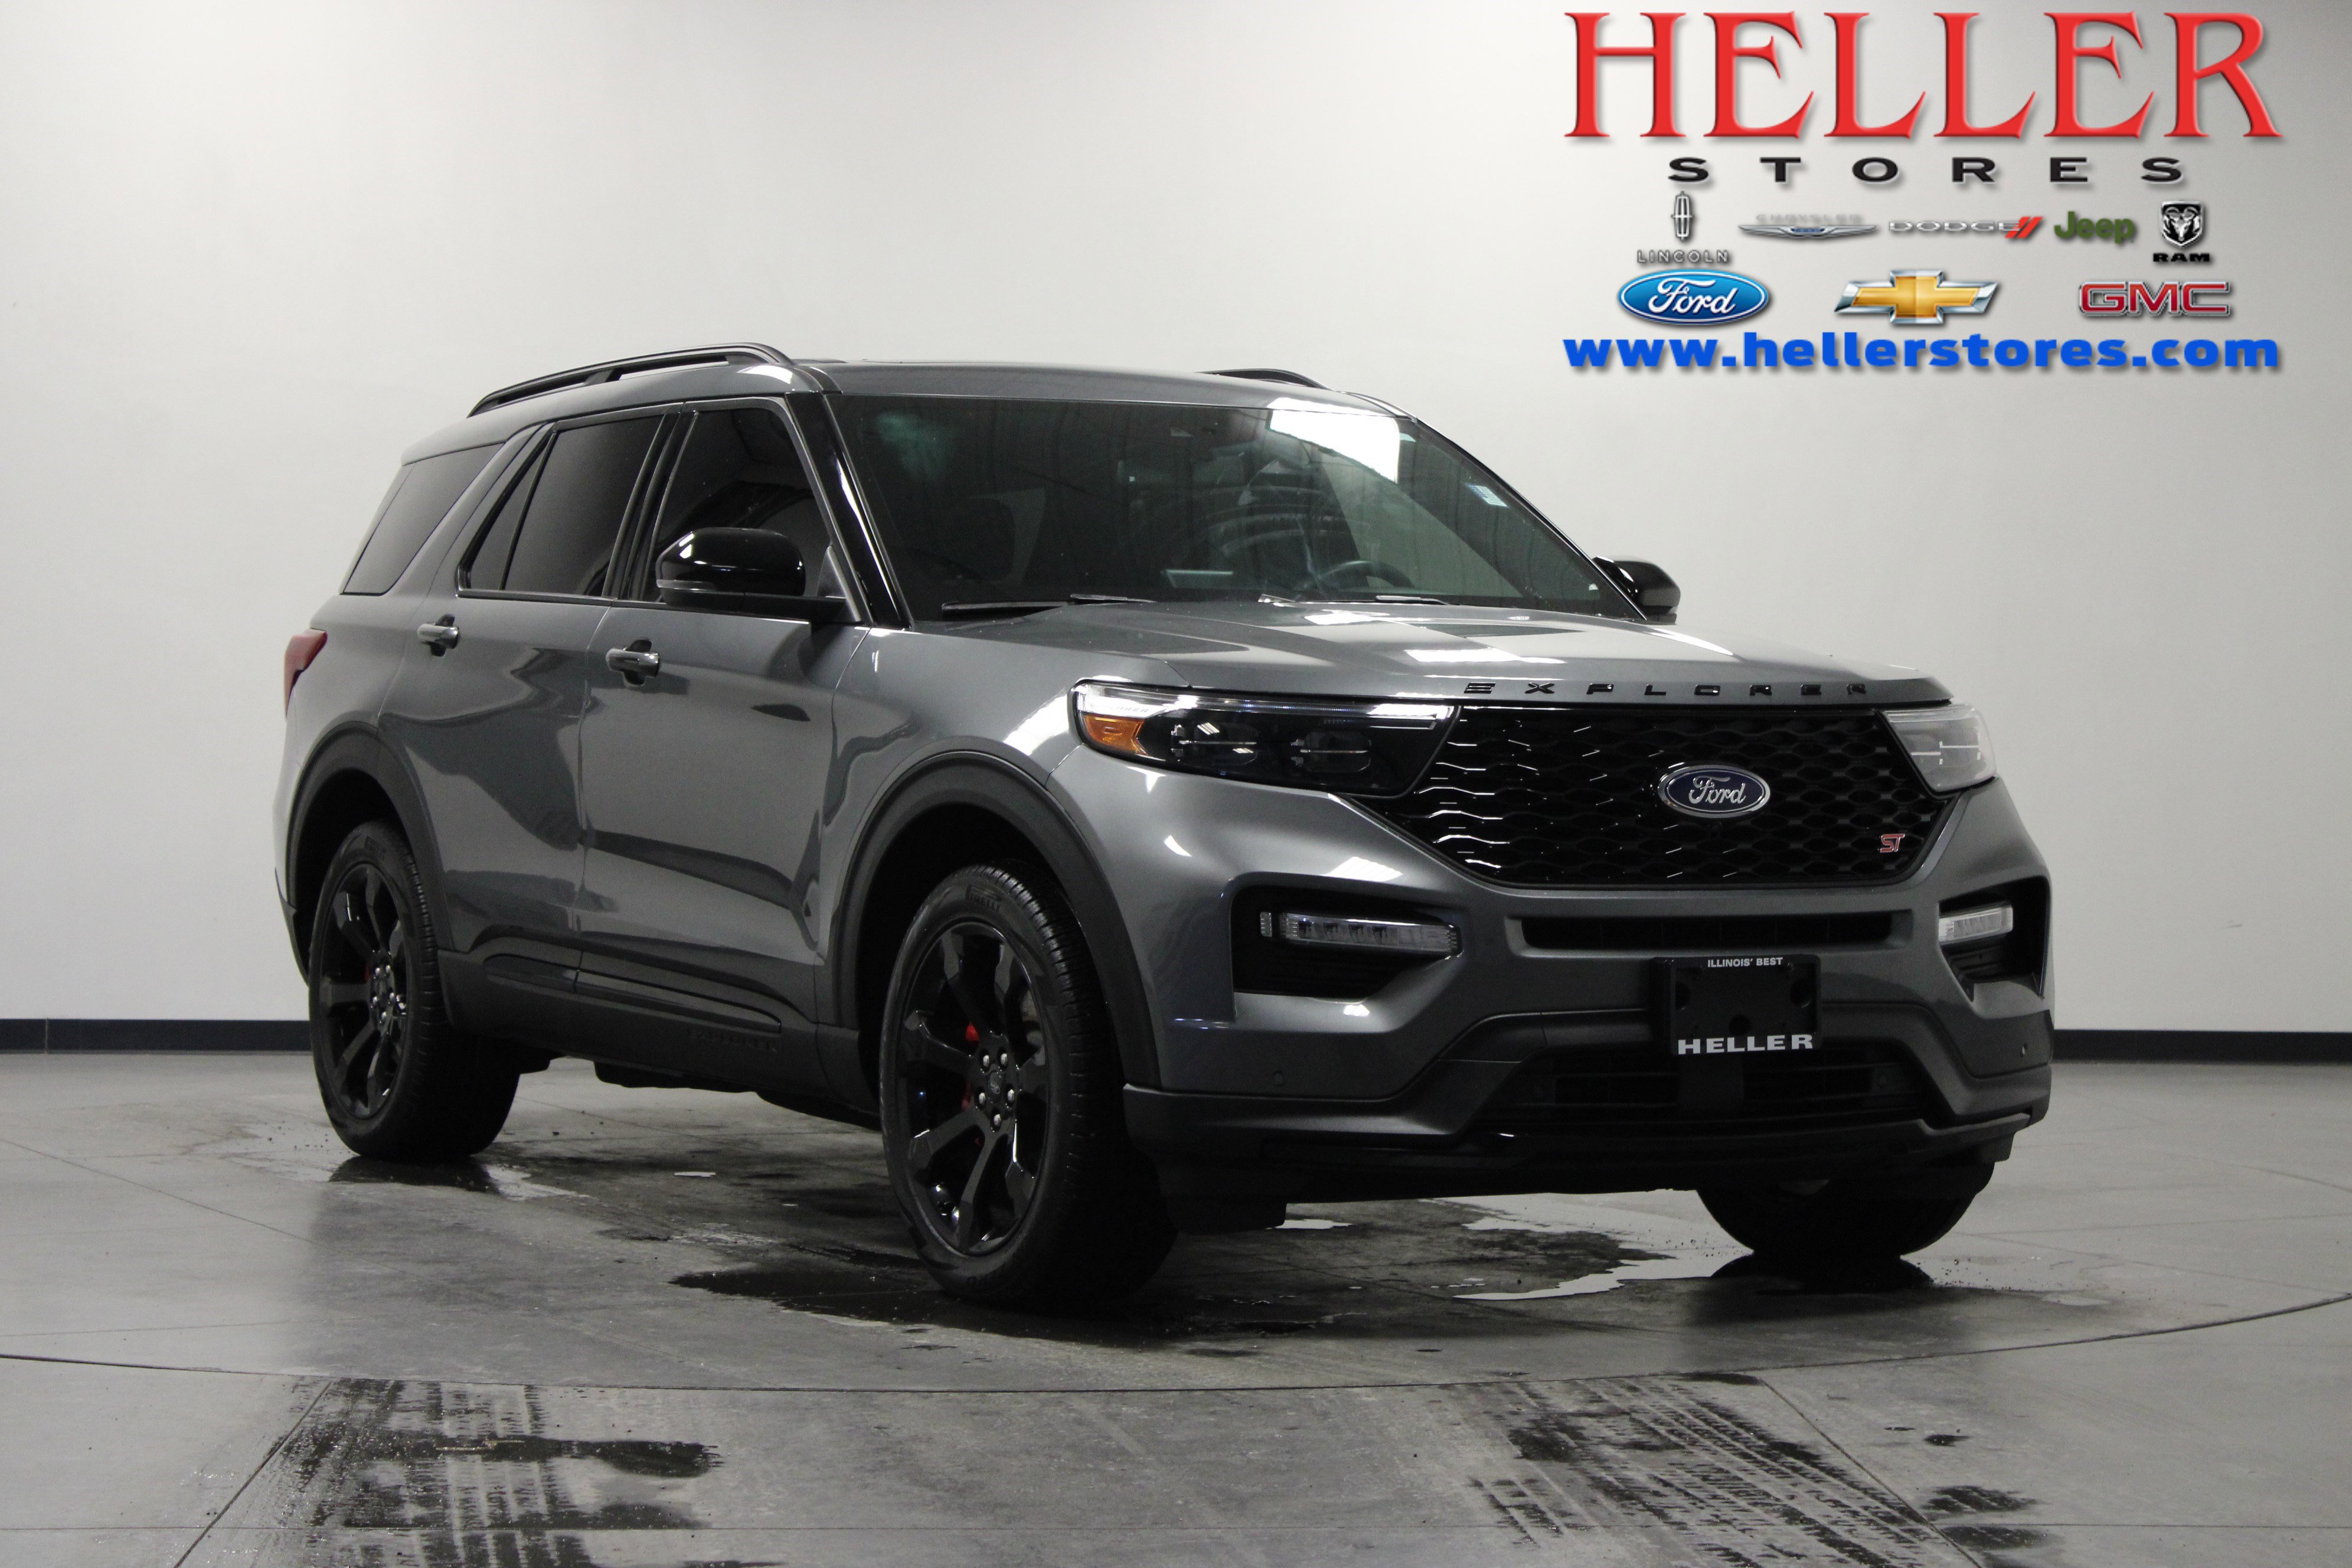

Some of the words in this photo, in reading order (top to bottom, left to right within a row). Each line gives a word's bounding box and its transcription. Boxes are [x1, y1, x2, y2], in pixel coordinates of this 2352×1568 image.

[1464, 682, 1866, 695] EXPLORER
[1688, 776, 1746, 804] Ford
[1880, 834, 1905, 853] ST
[1756, 957, 1783, 966] BEST
[1678, 1034, 1813, 1055] HELLER
